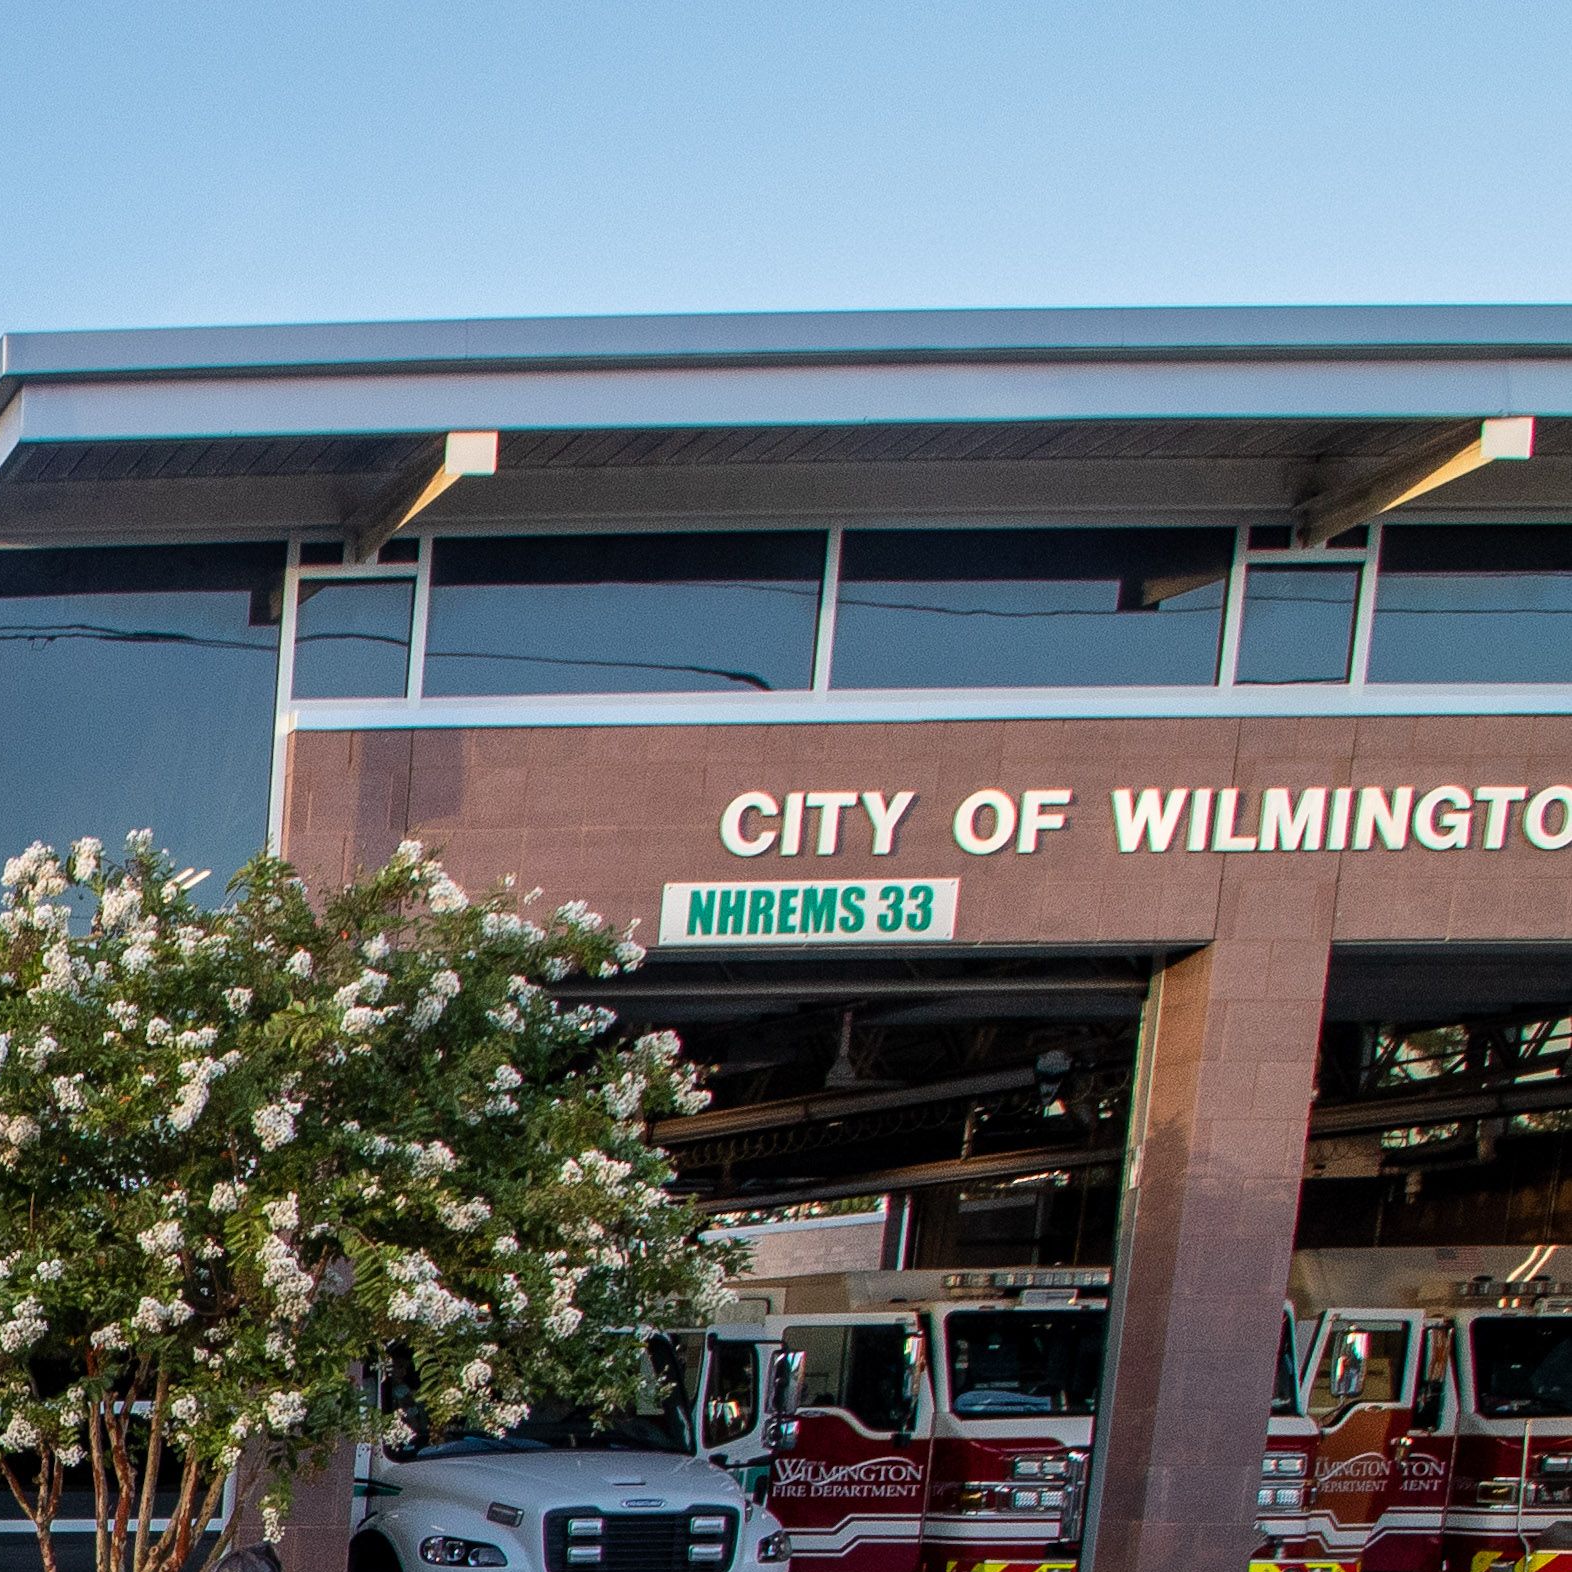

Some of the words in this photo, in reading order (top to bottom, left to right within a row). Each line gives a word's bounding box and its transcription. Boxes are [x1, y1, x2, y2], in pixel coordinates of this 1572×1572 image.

[720, 789, 916, 858] CITY
[953, 787, 1072, 856] OF
[1111, 785, 1572, 853] WILMINGTO
[686, 886, 866, 937] NHREMS
[877, 884, 934, 932] 33
[771, 1485, 807, 1497] FIRE
[810, 1484, 921, 1497] DEPARTMENT
[773, 1458, 925, 1486] WILMINGTON
